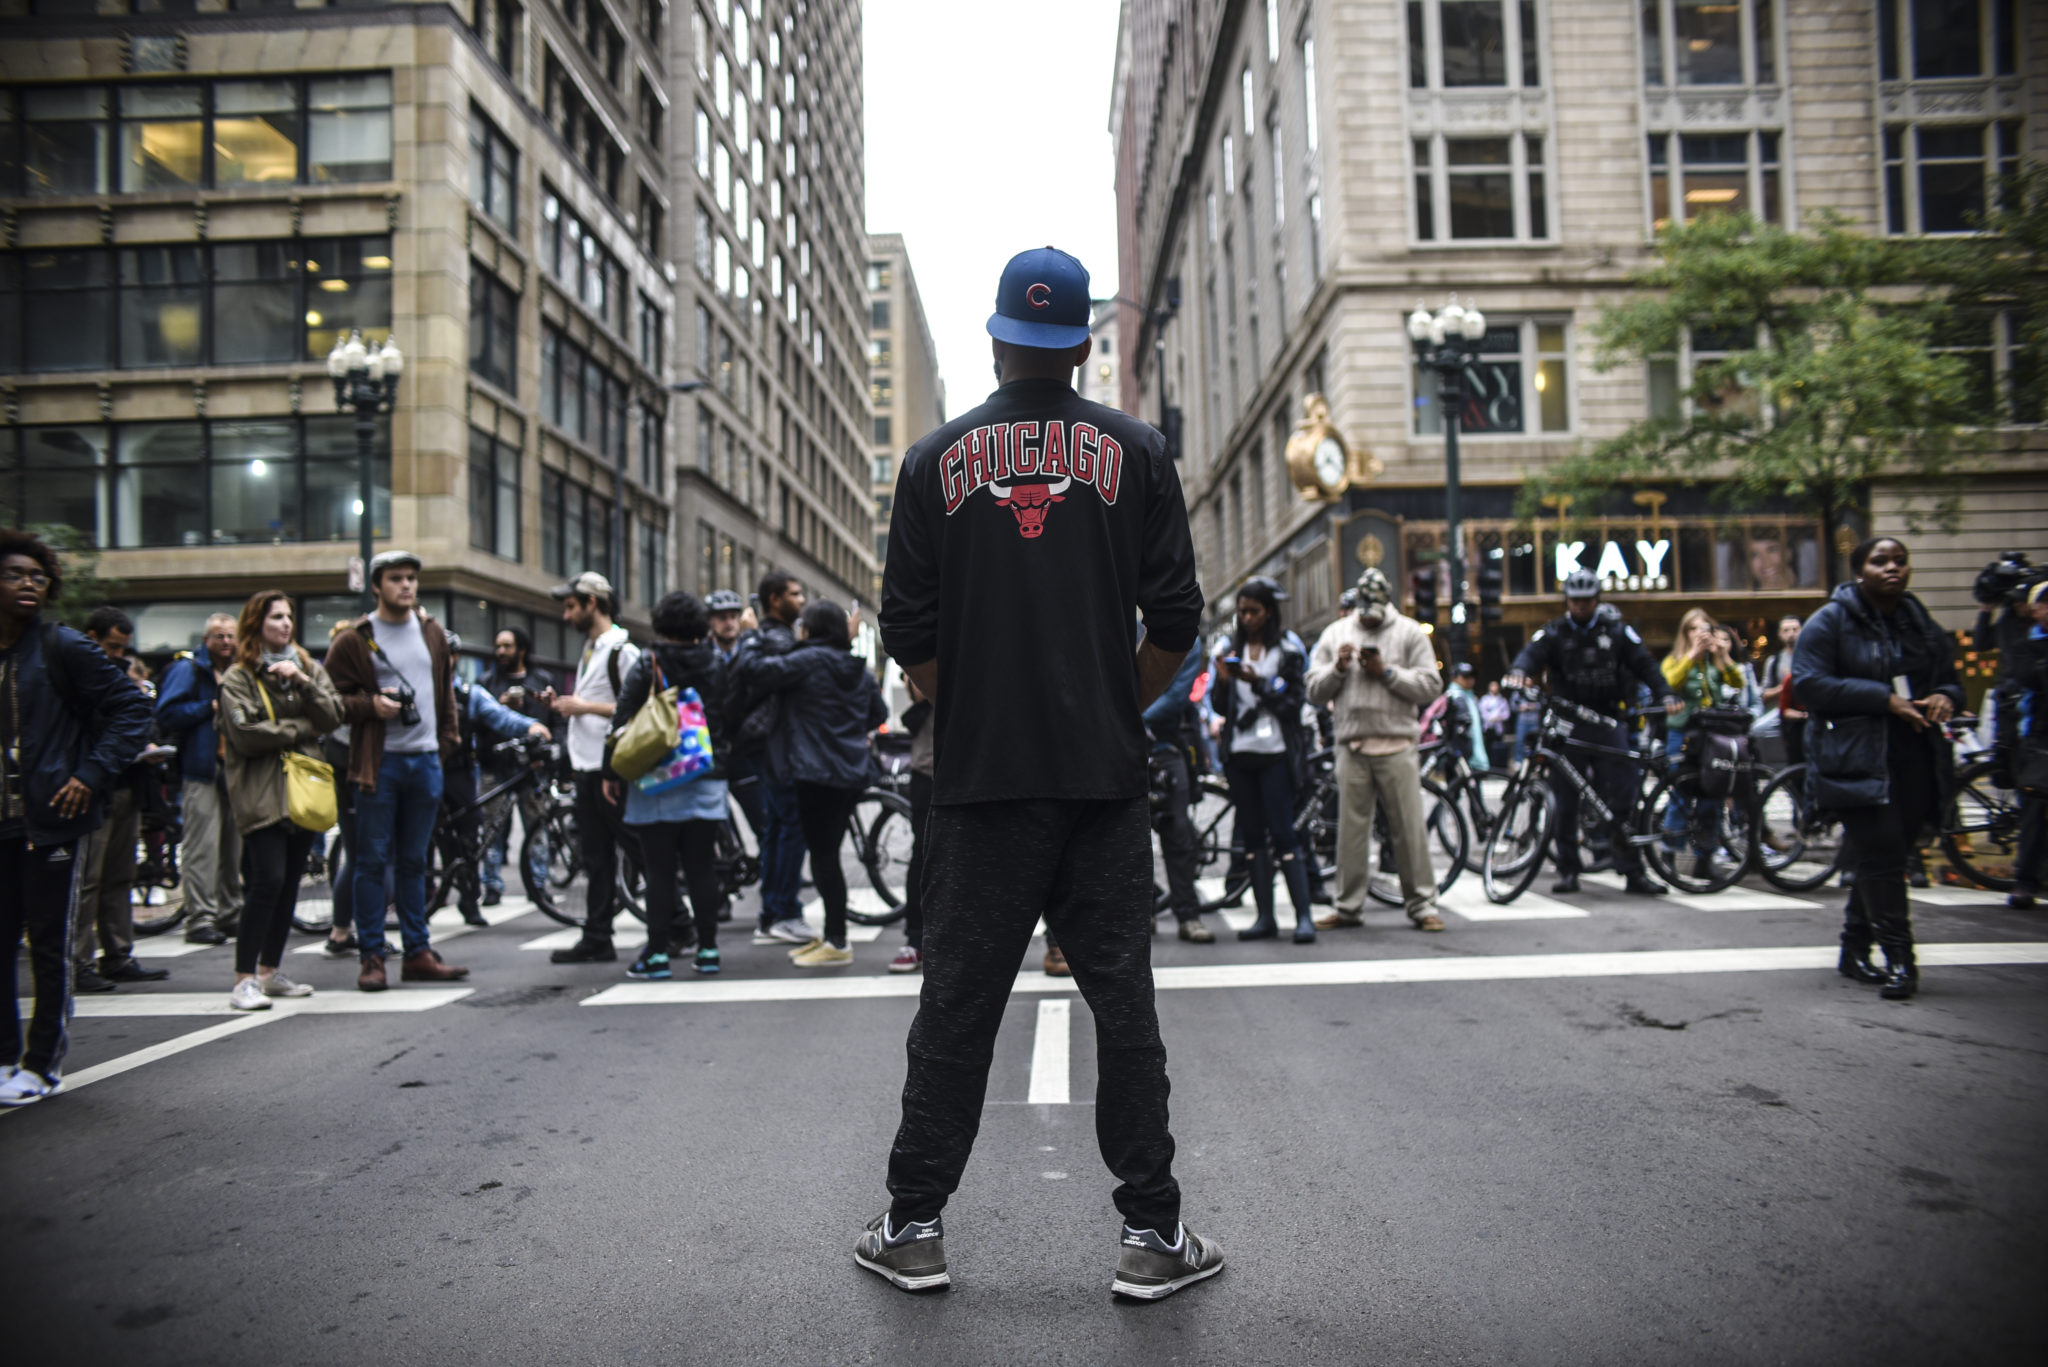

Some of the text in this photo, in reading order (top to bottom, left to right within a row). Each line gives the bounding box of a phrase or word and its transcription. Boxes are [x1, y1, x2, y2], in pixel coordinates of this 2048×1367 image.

[1026, 283, 1051, 310] C
[939, 420, 1123, 516] CHICAGO
[1555, 540, 1670, 581] KAY
[916, 1231, 939, 1239] balance
[1123, 1238, 1147, 1247] balance
